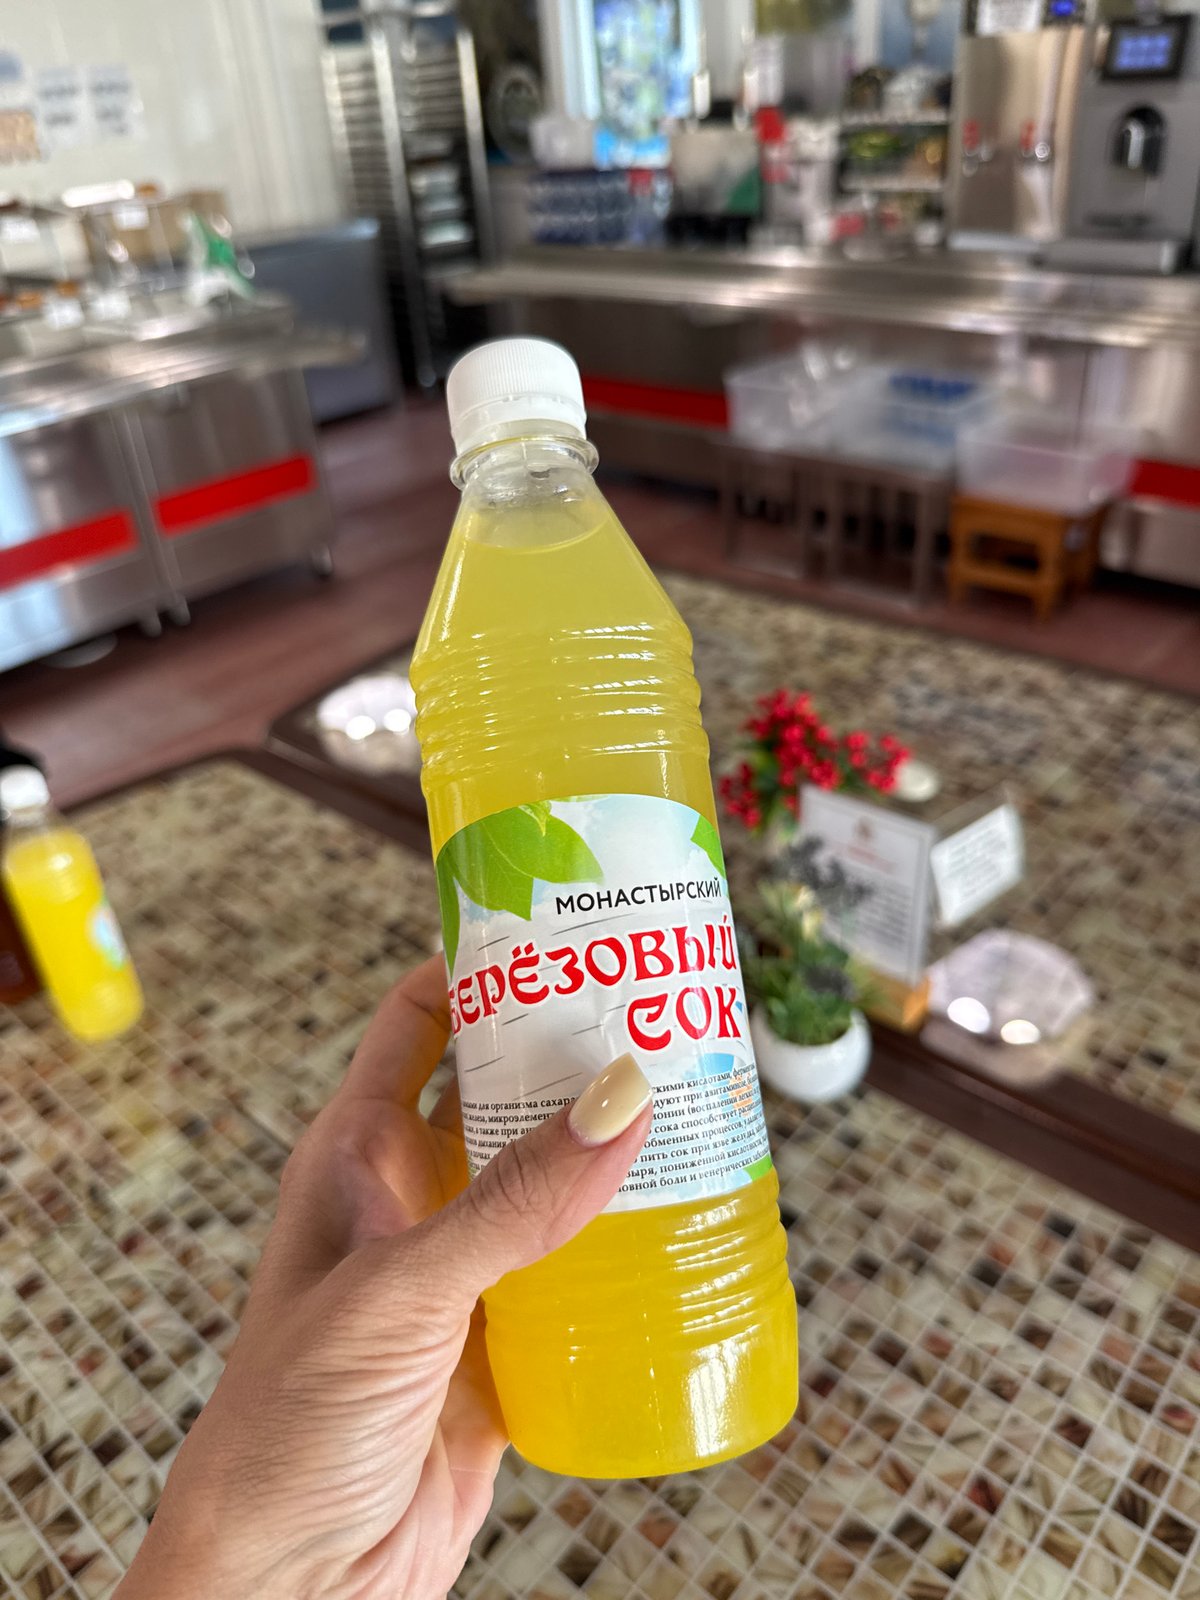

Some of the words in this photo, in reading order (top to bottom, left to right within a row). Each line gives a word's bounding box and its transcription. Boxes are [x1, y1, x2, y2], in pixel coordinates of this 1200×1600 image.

[555, 877, 722, 914] МОНАСТЫРСКИЙ
[627, 986, 741, 1051] СОК
[490, 1101, 538, 1113] организма
[683, 1093, 703, 1104] при
[654, 1123, 679, 1134] сока
[681, 1109, 738, 1129] способствует
[501, 1128, 518, 1138] при
[644, 1132, 699, 1149] обменных
[640, 1152, 668, 1163] пить
[670, 1148, 689, 1158] сок
[691, 1143, 711, 1155] при
[659, 1150, 726, 1174] пониженной
[659, 1175, 687, 1187] боли
[689, 1173, 697, 1182] и
